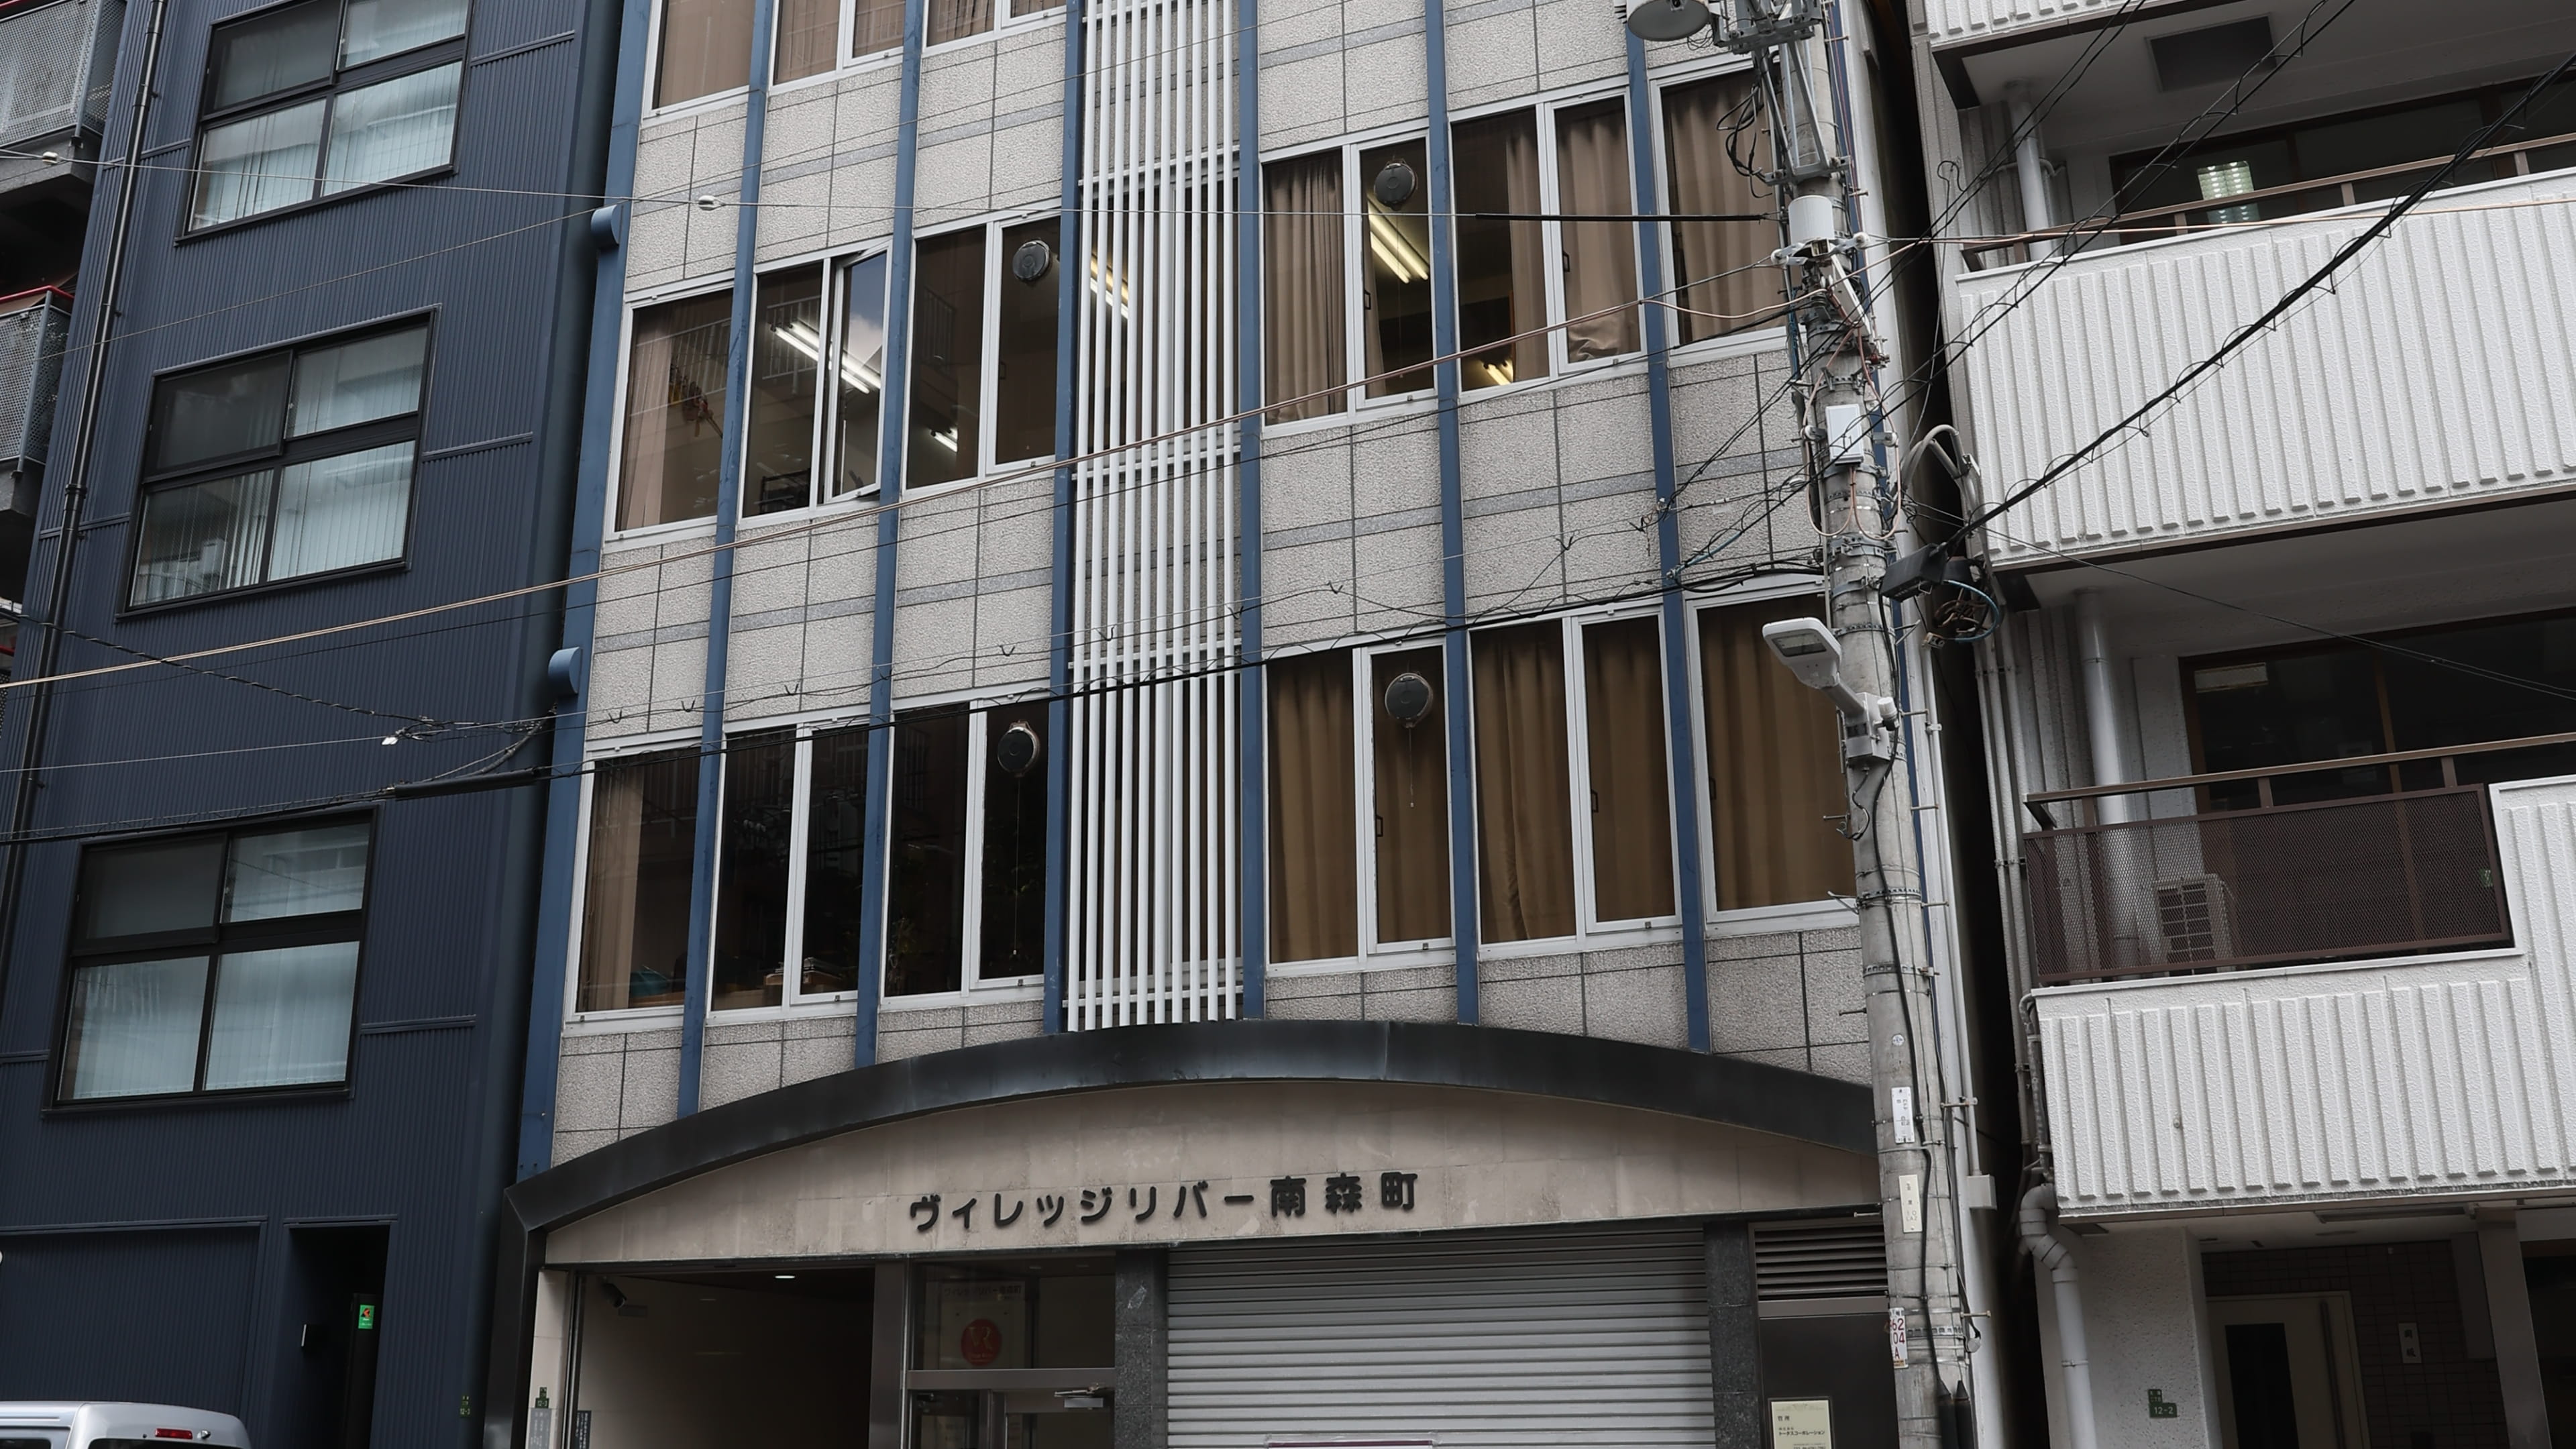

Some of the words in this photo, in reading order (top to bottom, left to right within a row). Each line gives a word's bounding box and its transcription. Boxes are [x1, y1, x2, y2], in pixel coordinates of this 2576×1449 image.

[910, 1173, 1417, 1231] ヴィレッジリバー南森町
[1890, 1318, 1904, 1331] 62
[2154, 1406, 2174, 1415] 12-2
